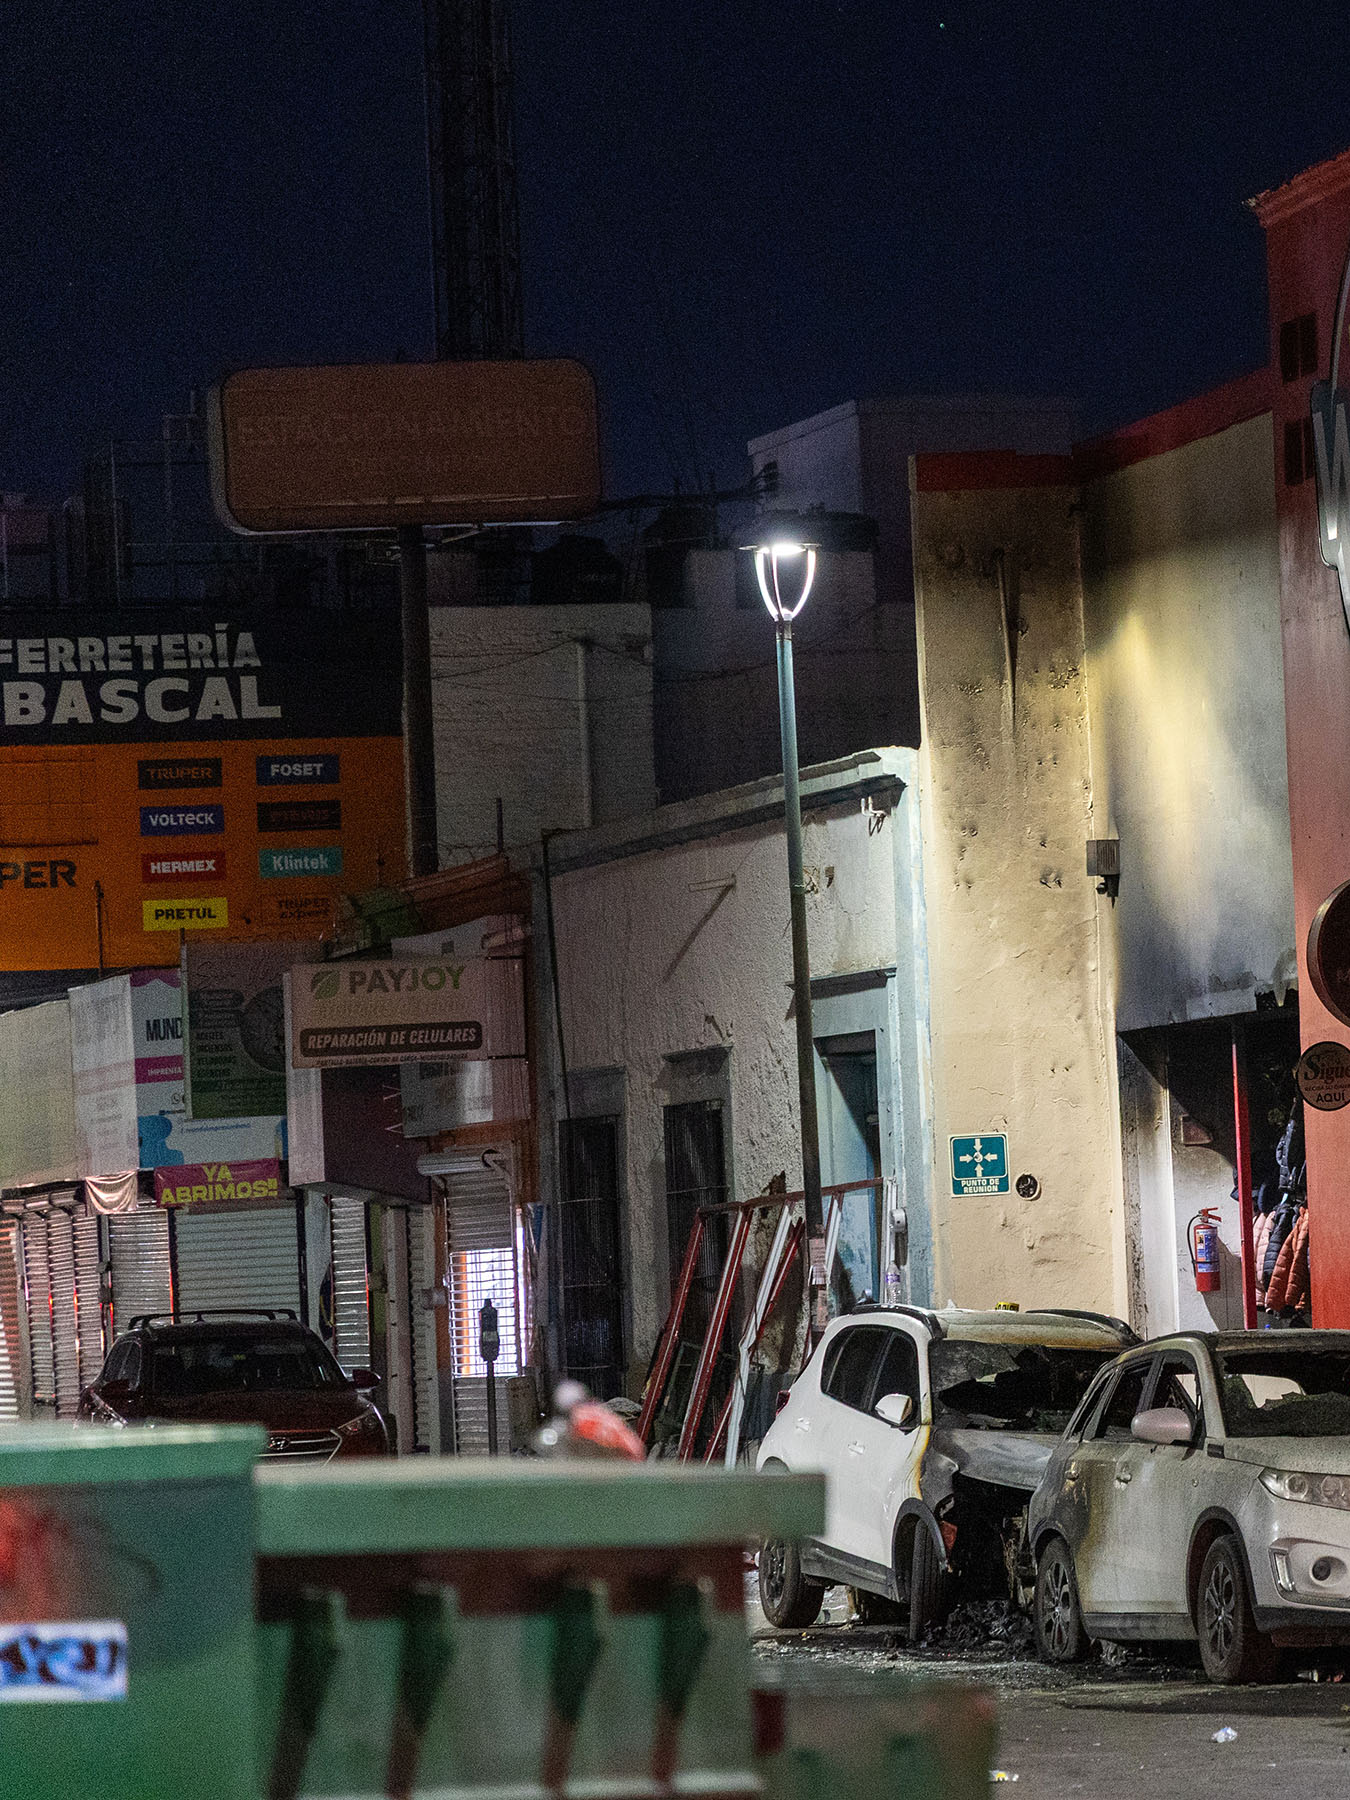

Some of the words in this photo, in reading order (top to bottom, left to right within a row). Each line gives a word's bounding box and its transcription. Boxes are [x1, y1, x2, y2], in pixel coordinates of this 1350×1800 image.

[237, 406, 587, 446] ESTACIONAMIENTO
[3, 675, 283, 726] BASCAL
[146, 765, 213, 781] TRUPER
[270, 762, 324, 777] FOSET
[150, 858, 217, 874] HERMEX
[272, 854, 330, 872] Klintek
[0, 859, 77, 889] PER
[154, 906, 217, 921] PRETUL
[348, 966, 467, 995] PAYJOY
[146, 1017, 183, 1042] MUND
[307, 1028, 387, 1049] REPARACIÓN
[390, 1030, 406, 1045] DE
[409, 1027, 477, 1044] CELULARES
[1316, 1090, 1345, 1103] AQUÍ
[202, 1165, 234, 1183] YA
[961, 1178, 987, 1187] PUNTO
